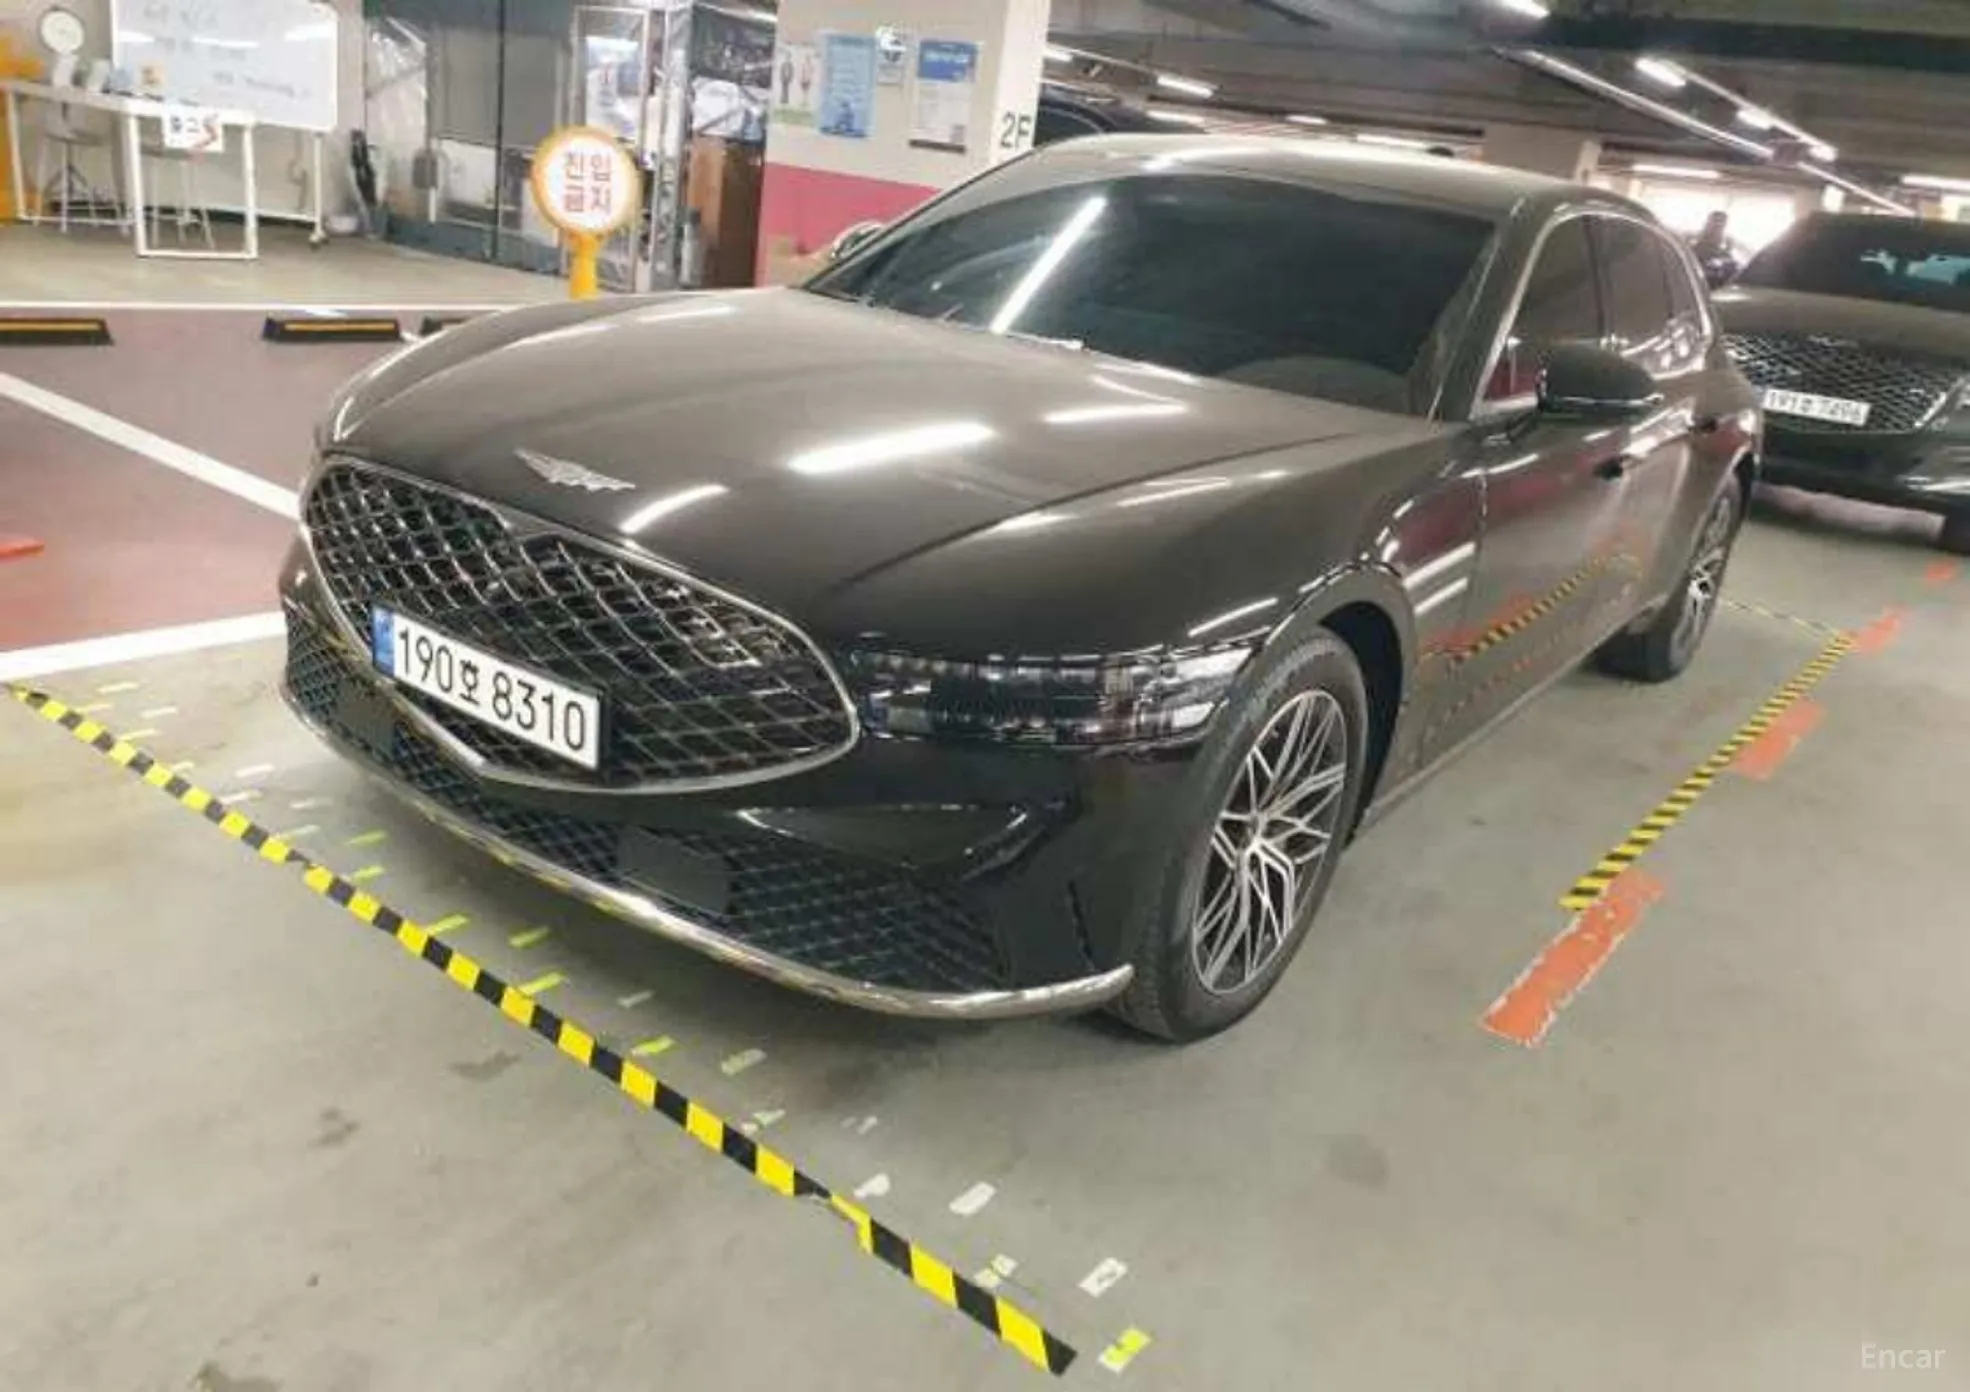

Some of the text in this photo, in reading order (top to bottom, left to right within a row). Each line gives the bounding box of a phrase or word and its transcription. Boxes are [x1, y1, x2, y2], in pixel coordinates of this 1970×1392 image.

[1000, 110, 1032, 151] 2F
[398, 627, 586, 751] 190호 8310
